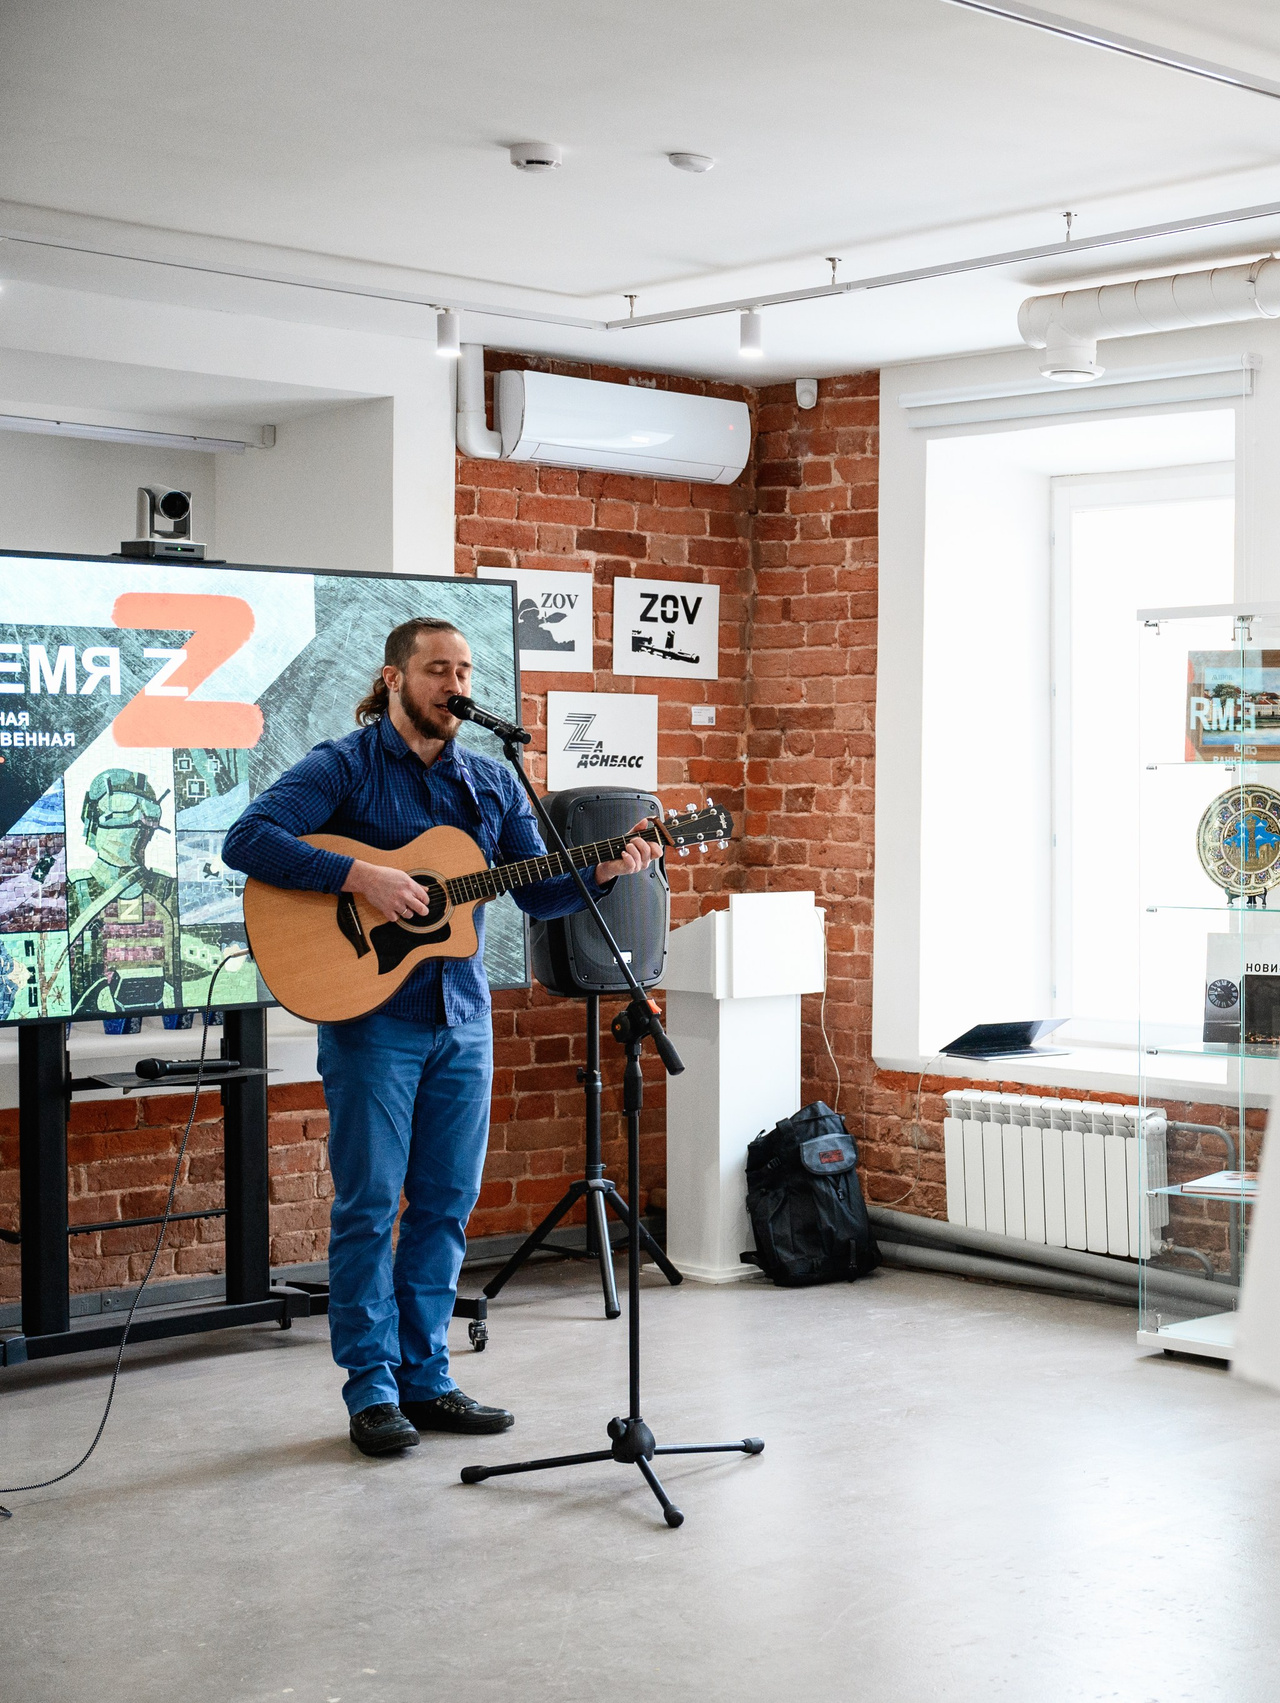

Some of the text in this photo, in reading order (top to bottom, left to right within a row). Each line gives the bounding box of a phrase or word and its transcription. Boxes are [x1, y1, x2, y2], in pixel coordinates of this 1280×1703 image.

[541, 593, 579, 609] ZOV
[639, 592, 703, 625] ZOV
[111, 592, 265, 748] Z
[143, 648, 189, 697] Z
[0, 731, 76, 747] ВЕННАЯ
[576, 754, 644, 769] ДОНБАСС
